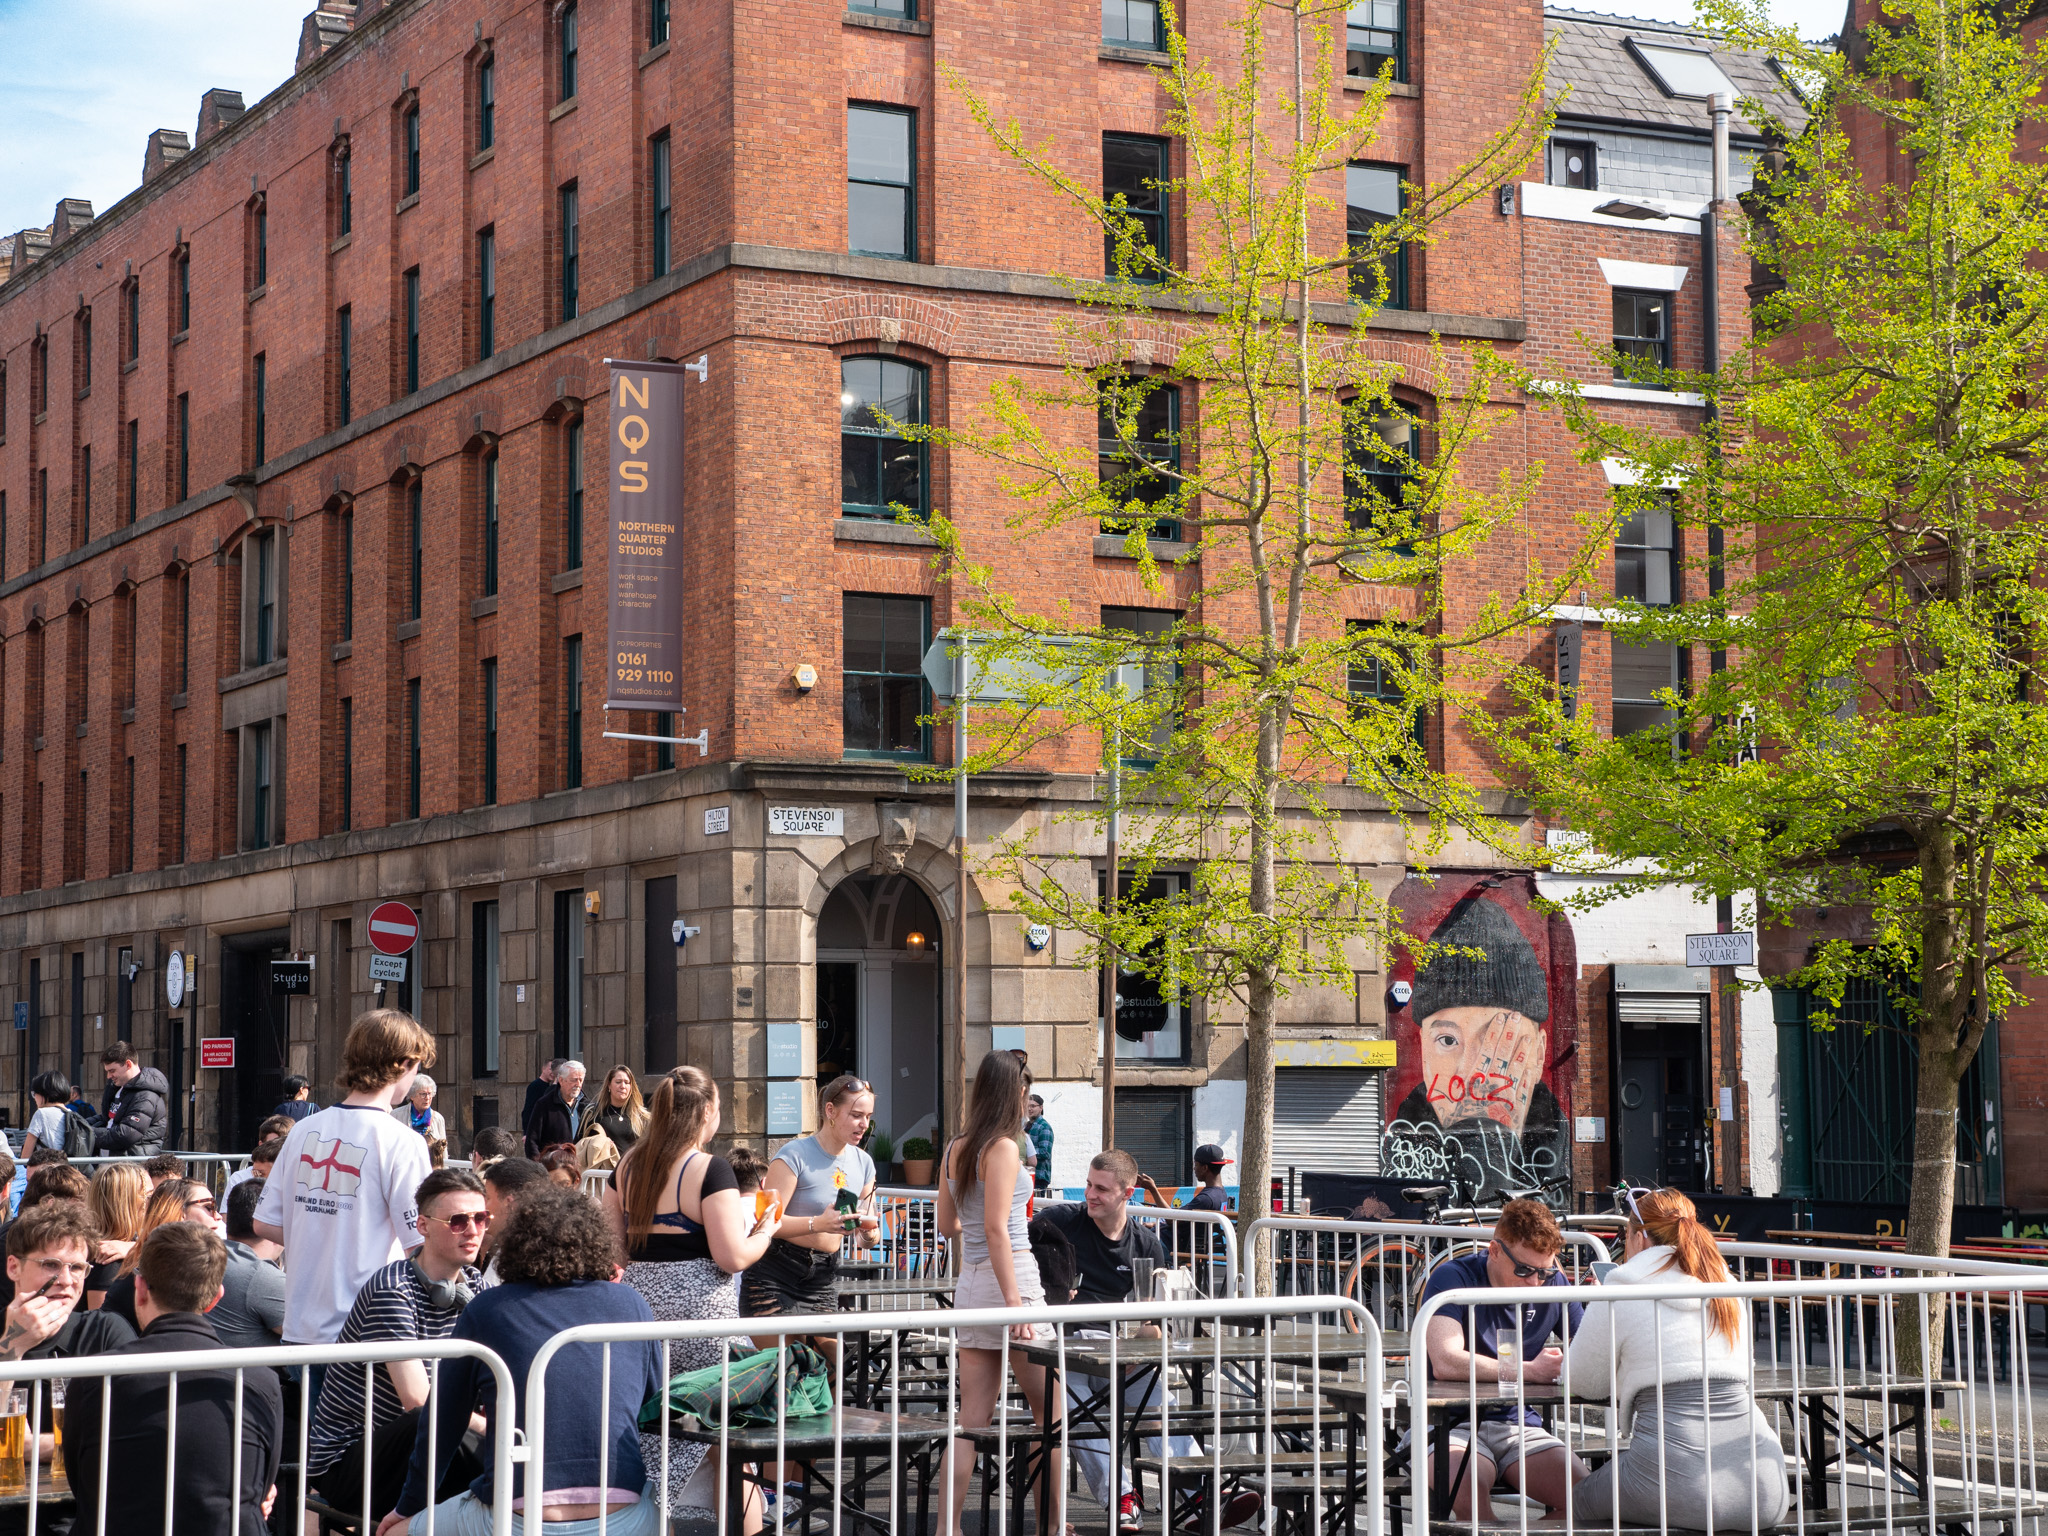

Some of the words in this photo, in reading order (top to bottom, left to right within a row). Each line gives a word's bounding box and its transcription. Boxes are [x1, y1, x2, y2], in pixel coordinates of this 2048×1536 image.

[618, 375, 650, 493] NQS
[618, 521, 675, 533] NORTHERN
[618, 533, 667, 545] QUARTER
[618, 545, 664, 556] STUDIOS
[618, 572, 636, 581] work
[637, 574, 658, 582] space
[618, 582, 634, 590] with
[618, 592, 657, 600] warehouse
[618, 600, 652, 608] character
[626, 641, 663, 649] PROPERTIES
[617, 652, 647, 666] 0161
[617, 668, 643, 682] 929
[646, 670, 674, 683] 1110
[617, 687, 673, 696] nqstudios.co.uk
[707, 809, 726, 820] HILTON
[707, 820, 726, 833] STREET
[783, 821, 824, 832] SQUARE
[1556, 832, 1584, 842] LITTLE
[1031, 928, 1048, 936] EXCEL
[1690, 935, 1748, 949] STEVENSON
[1699, 949, 1740, 963] SQUARE
[374, 957, 403, 969] Except
[374, 968, 401, 978] cycles
[273, 974, 309, 983] Studio
[1394, 987, 1411, 995] EXCEL
[1121, 997, 1162, 1007] estudio
[319, 1198, 335, 1208] EURO
[403, 1209, 417, 1220] EU
